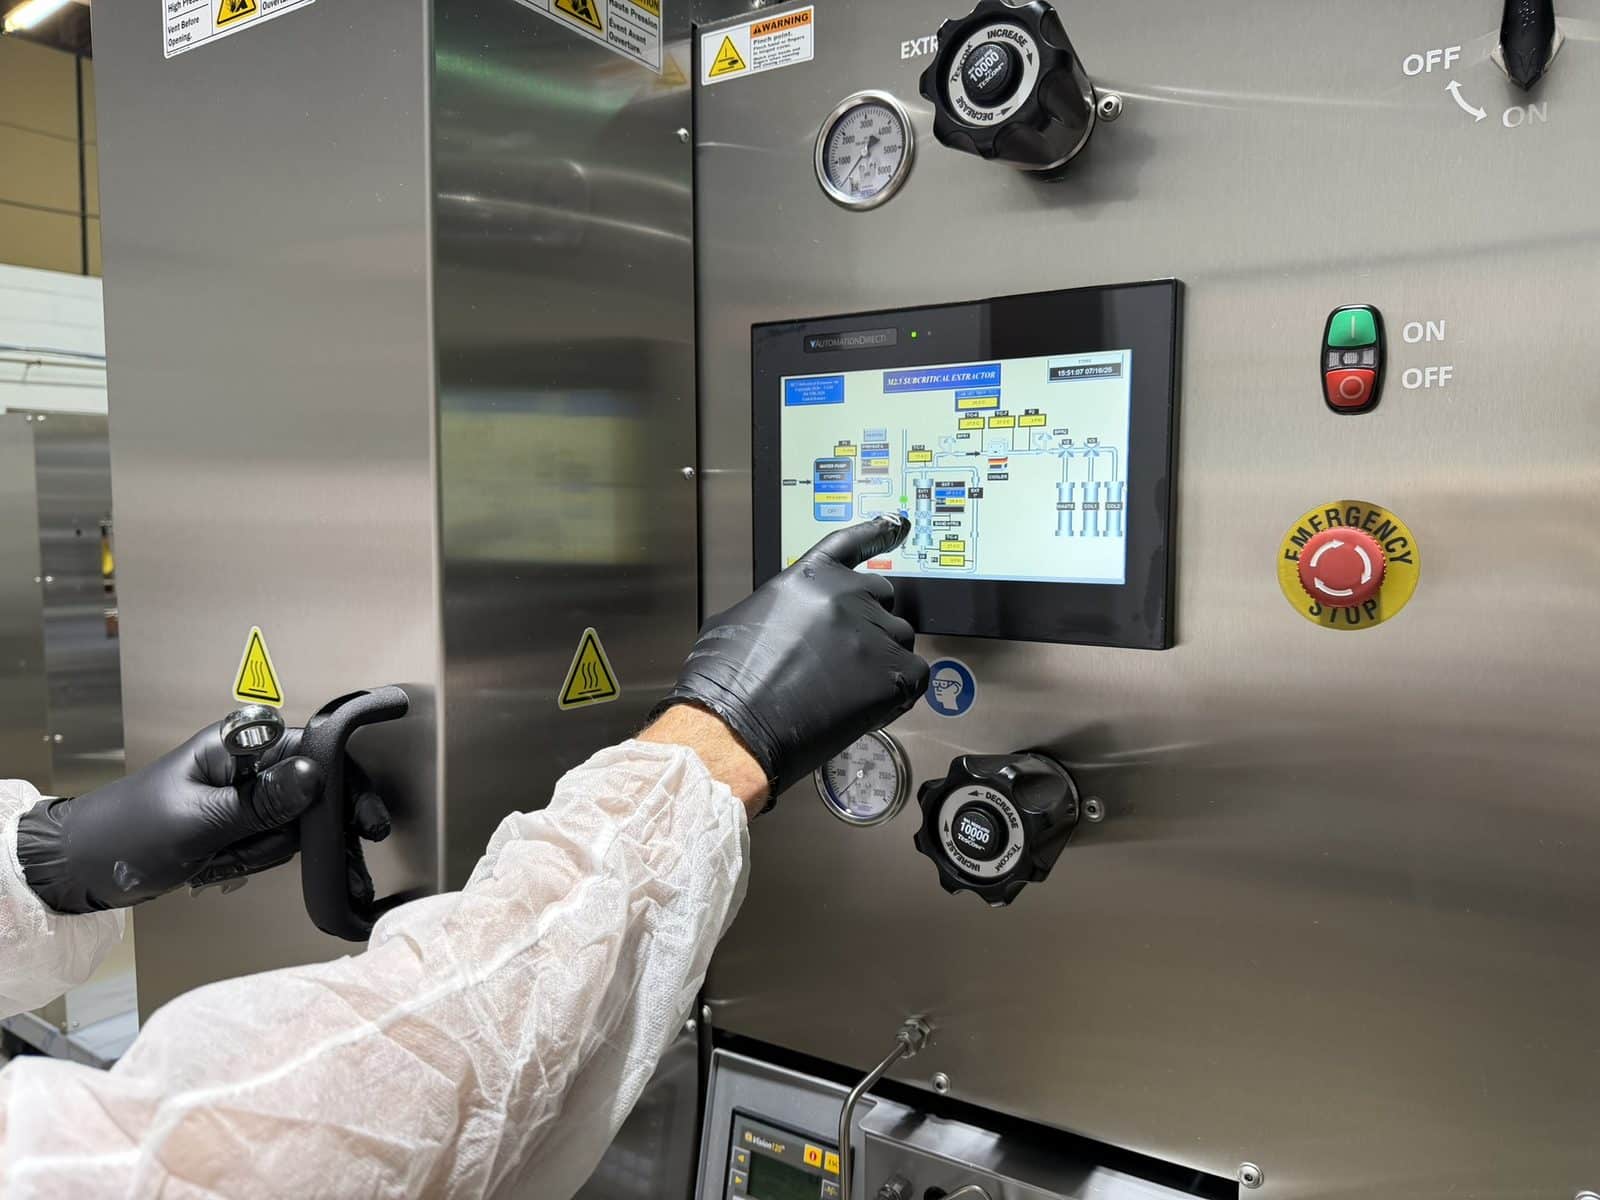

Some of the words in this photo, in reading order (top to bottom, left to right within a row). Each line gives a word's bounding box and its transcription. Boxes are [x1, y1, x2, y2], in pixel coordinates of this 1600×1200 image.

[167, 0, 181, 14] High
[630, 6, 658, 30] Pression
[168, 22, 181, 34] Vent
[181, 16, 199, 29] Before
[762, 13, 809, 31] WARNING
[168, 32, 193, 47] Opening.
[628, 27, 647, 45] Avant
[987, 29, 1028, 48] INCREASE
[969, 51, 999, 82] 10000
[1402, 46, 1461, 76] OFF
[956, 96, 994, 120] DECREASE
[1502, 102, 1548, 128] ON
[1402, 320, 1446, 343] ON
[903, 375, 951, 385] SUBCRITICAL
[951, 371, 996, 382] EXTRACTOR
[1401, 366, 1453, 389] OFF
[1285, 506, 1413, 565] EMERGENCY
[985, 792, 1019, 829] DECREASE
[960, 821, 989, 843] 10000
[946, 840, 980, 872] INCREASE
[994, 843, 1022, 872] TESCOM
